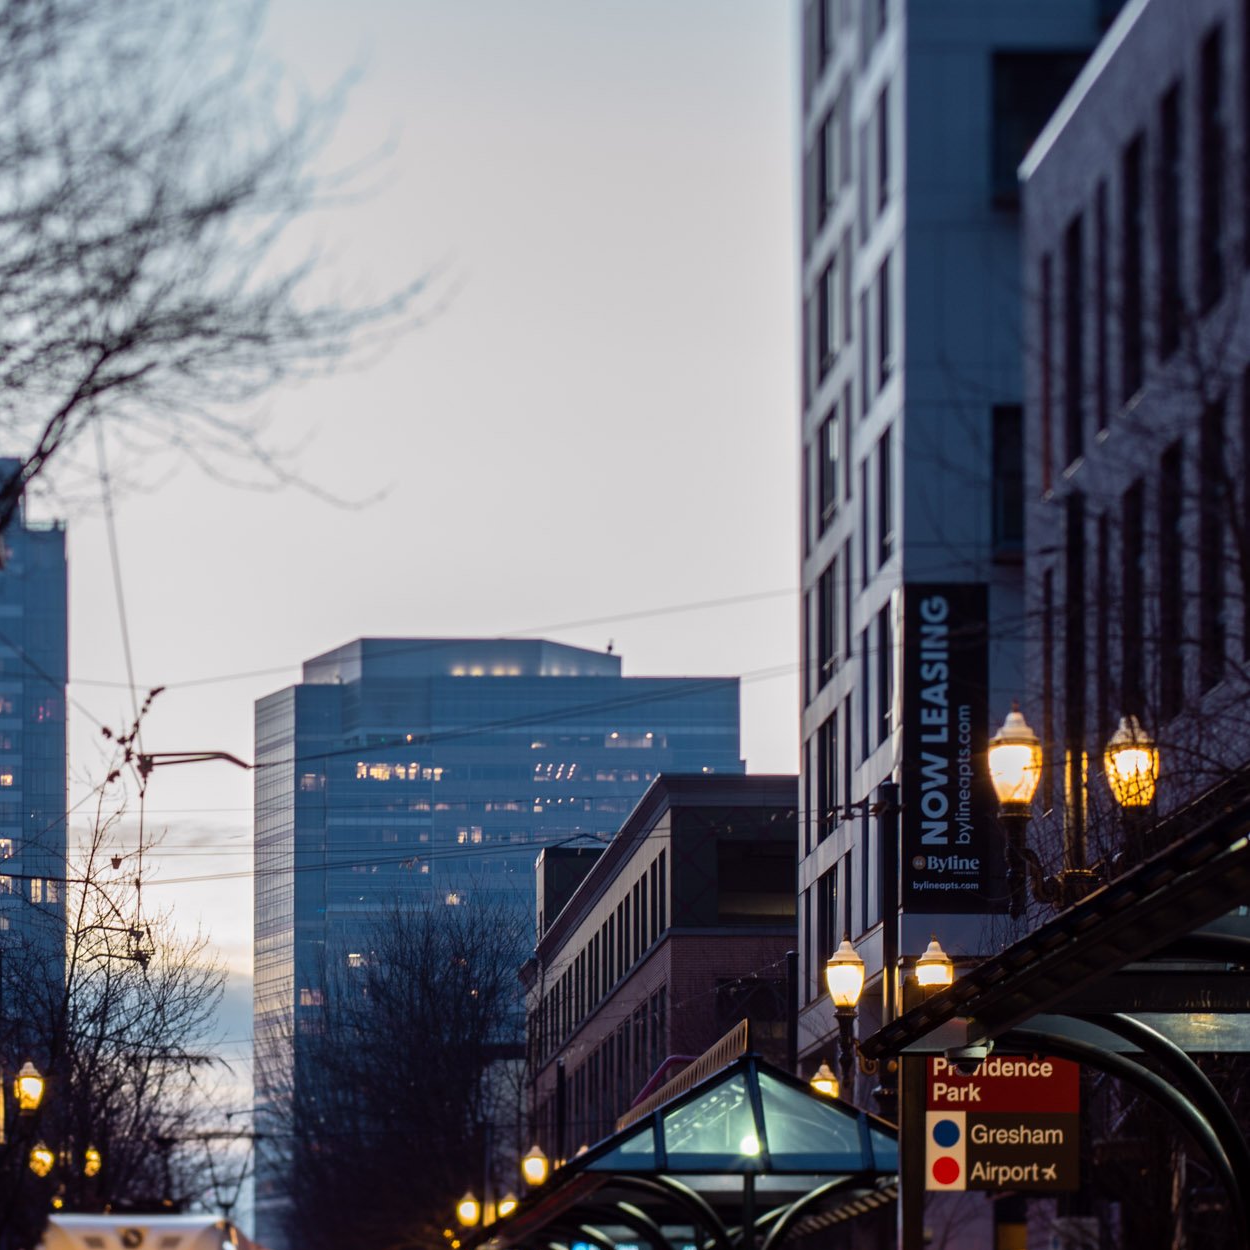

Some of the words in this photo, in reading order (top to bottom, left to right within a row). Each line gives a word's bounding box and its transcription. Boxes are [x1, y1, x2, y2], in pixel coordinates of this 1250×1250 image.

[920, 595, 949, 743] LEASING
[955, 704, 974, 844] bylineapts.com
[921, 751, 949, 845] NOW
[927, 855, 980, 873] Byline
[913, 881, 979, 891] bylineapts.com
[933, 1057, 1053, 1077] Pridence
[933, 1083, 981, 1102] Park
[971, 1124, 1064, 1144] Gresham
[971, 1161, 1039, 1186] Airport
